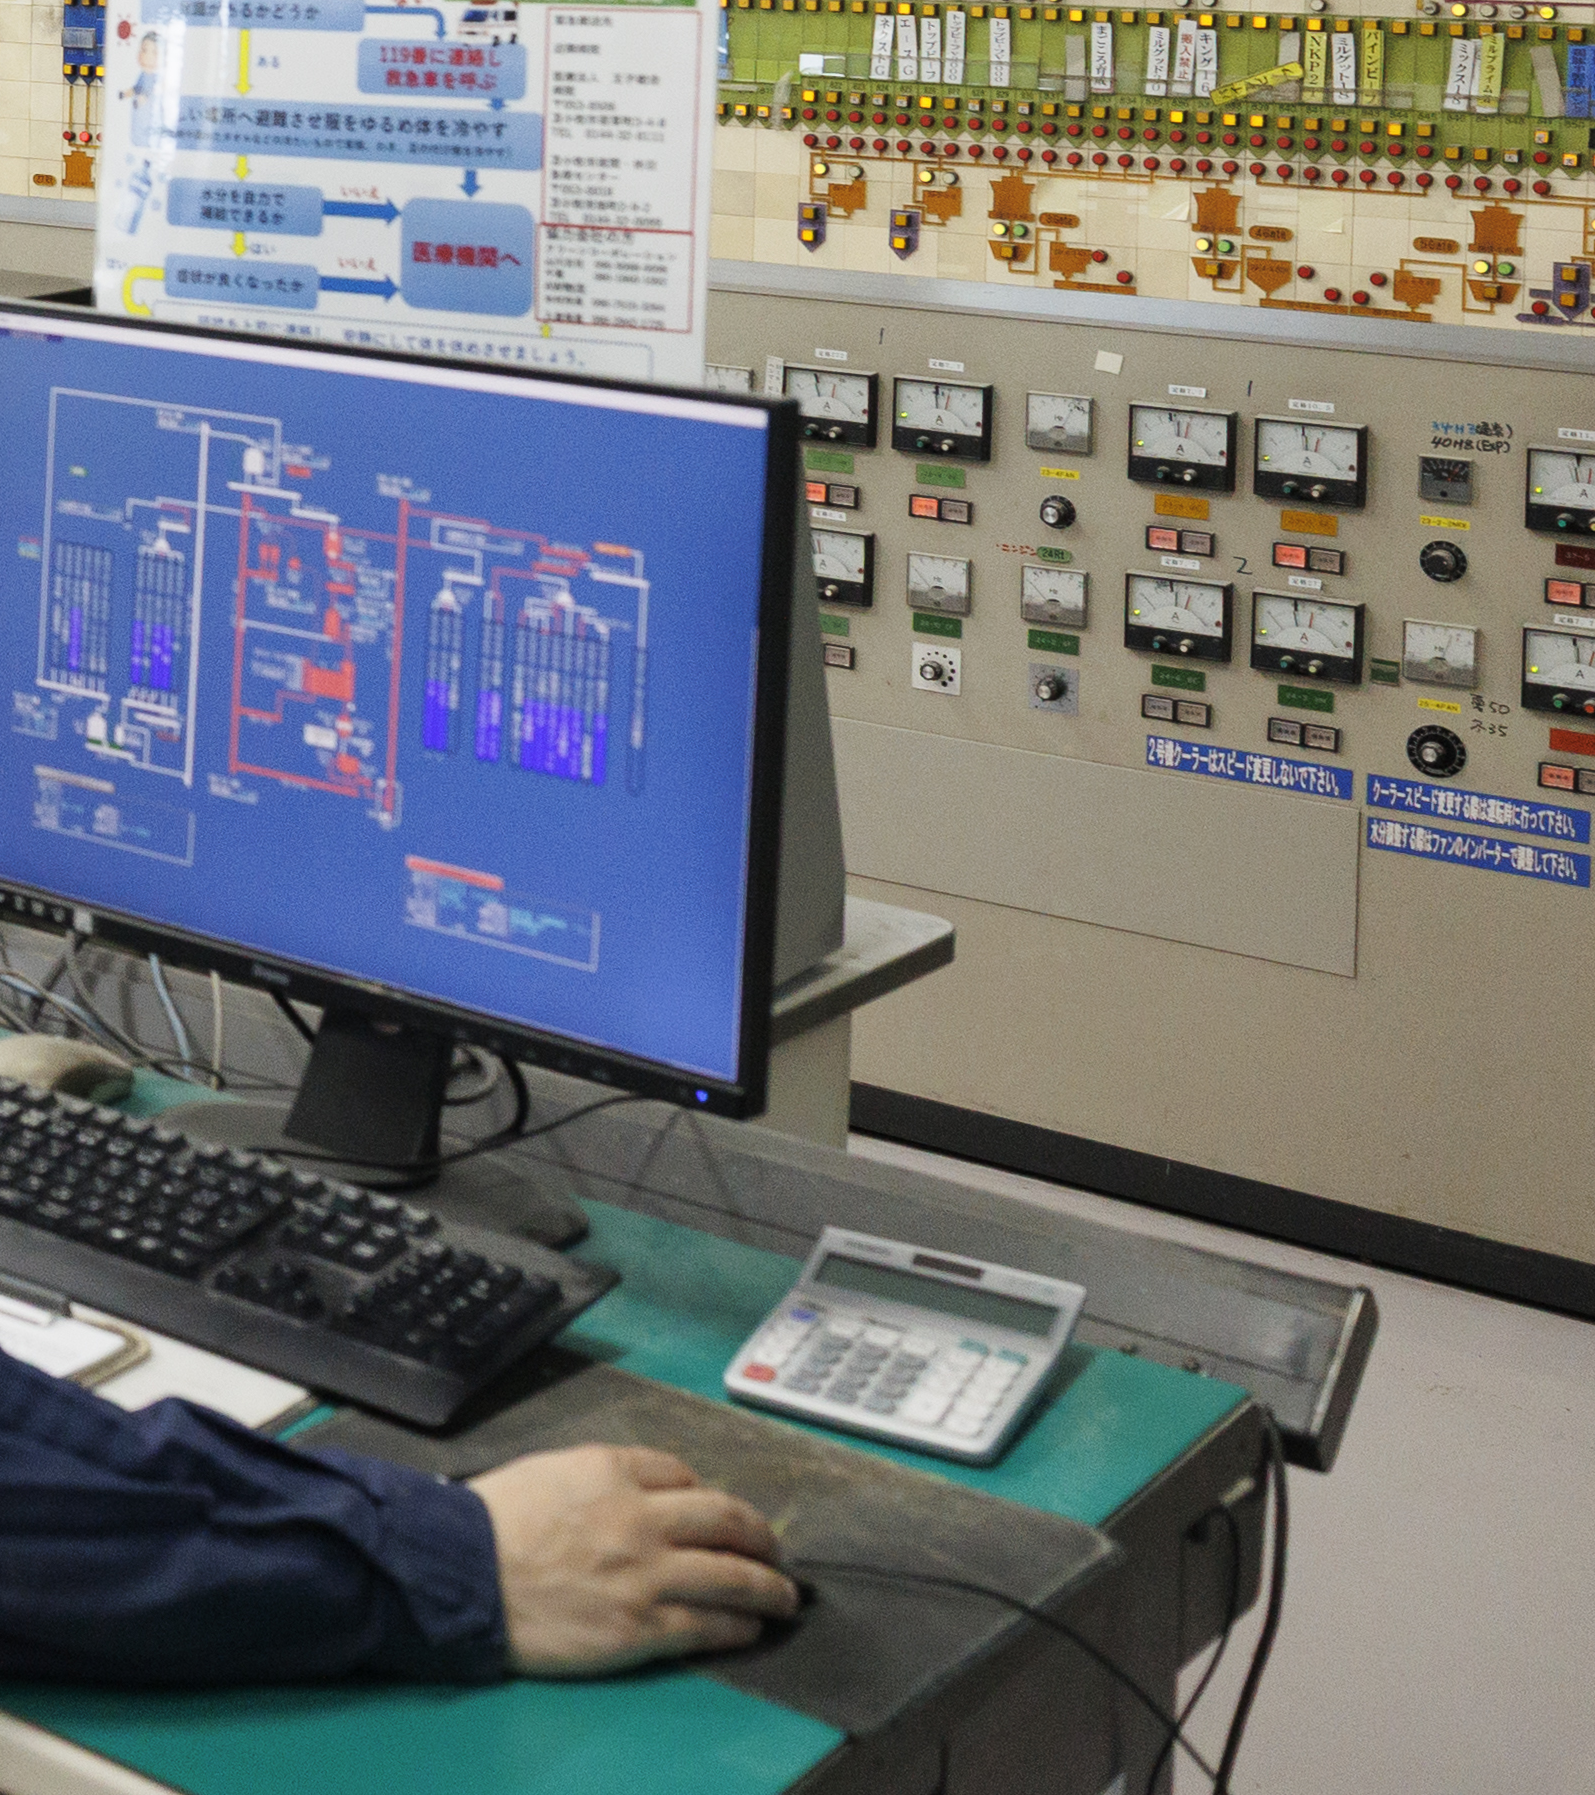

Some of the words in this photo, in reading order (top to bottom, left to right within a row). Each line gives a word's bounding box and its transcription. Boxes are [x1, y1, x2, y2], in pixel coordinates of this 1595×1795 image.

[384, 69, 498, 91] 救急車を呼ぶ
[412, 240, 522, 269] 医療機関へ
[1148, 736, 1341, 797] 2号機クーラーはスピード変更しないで下さい。
